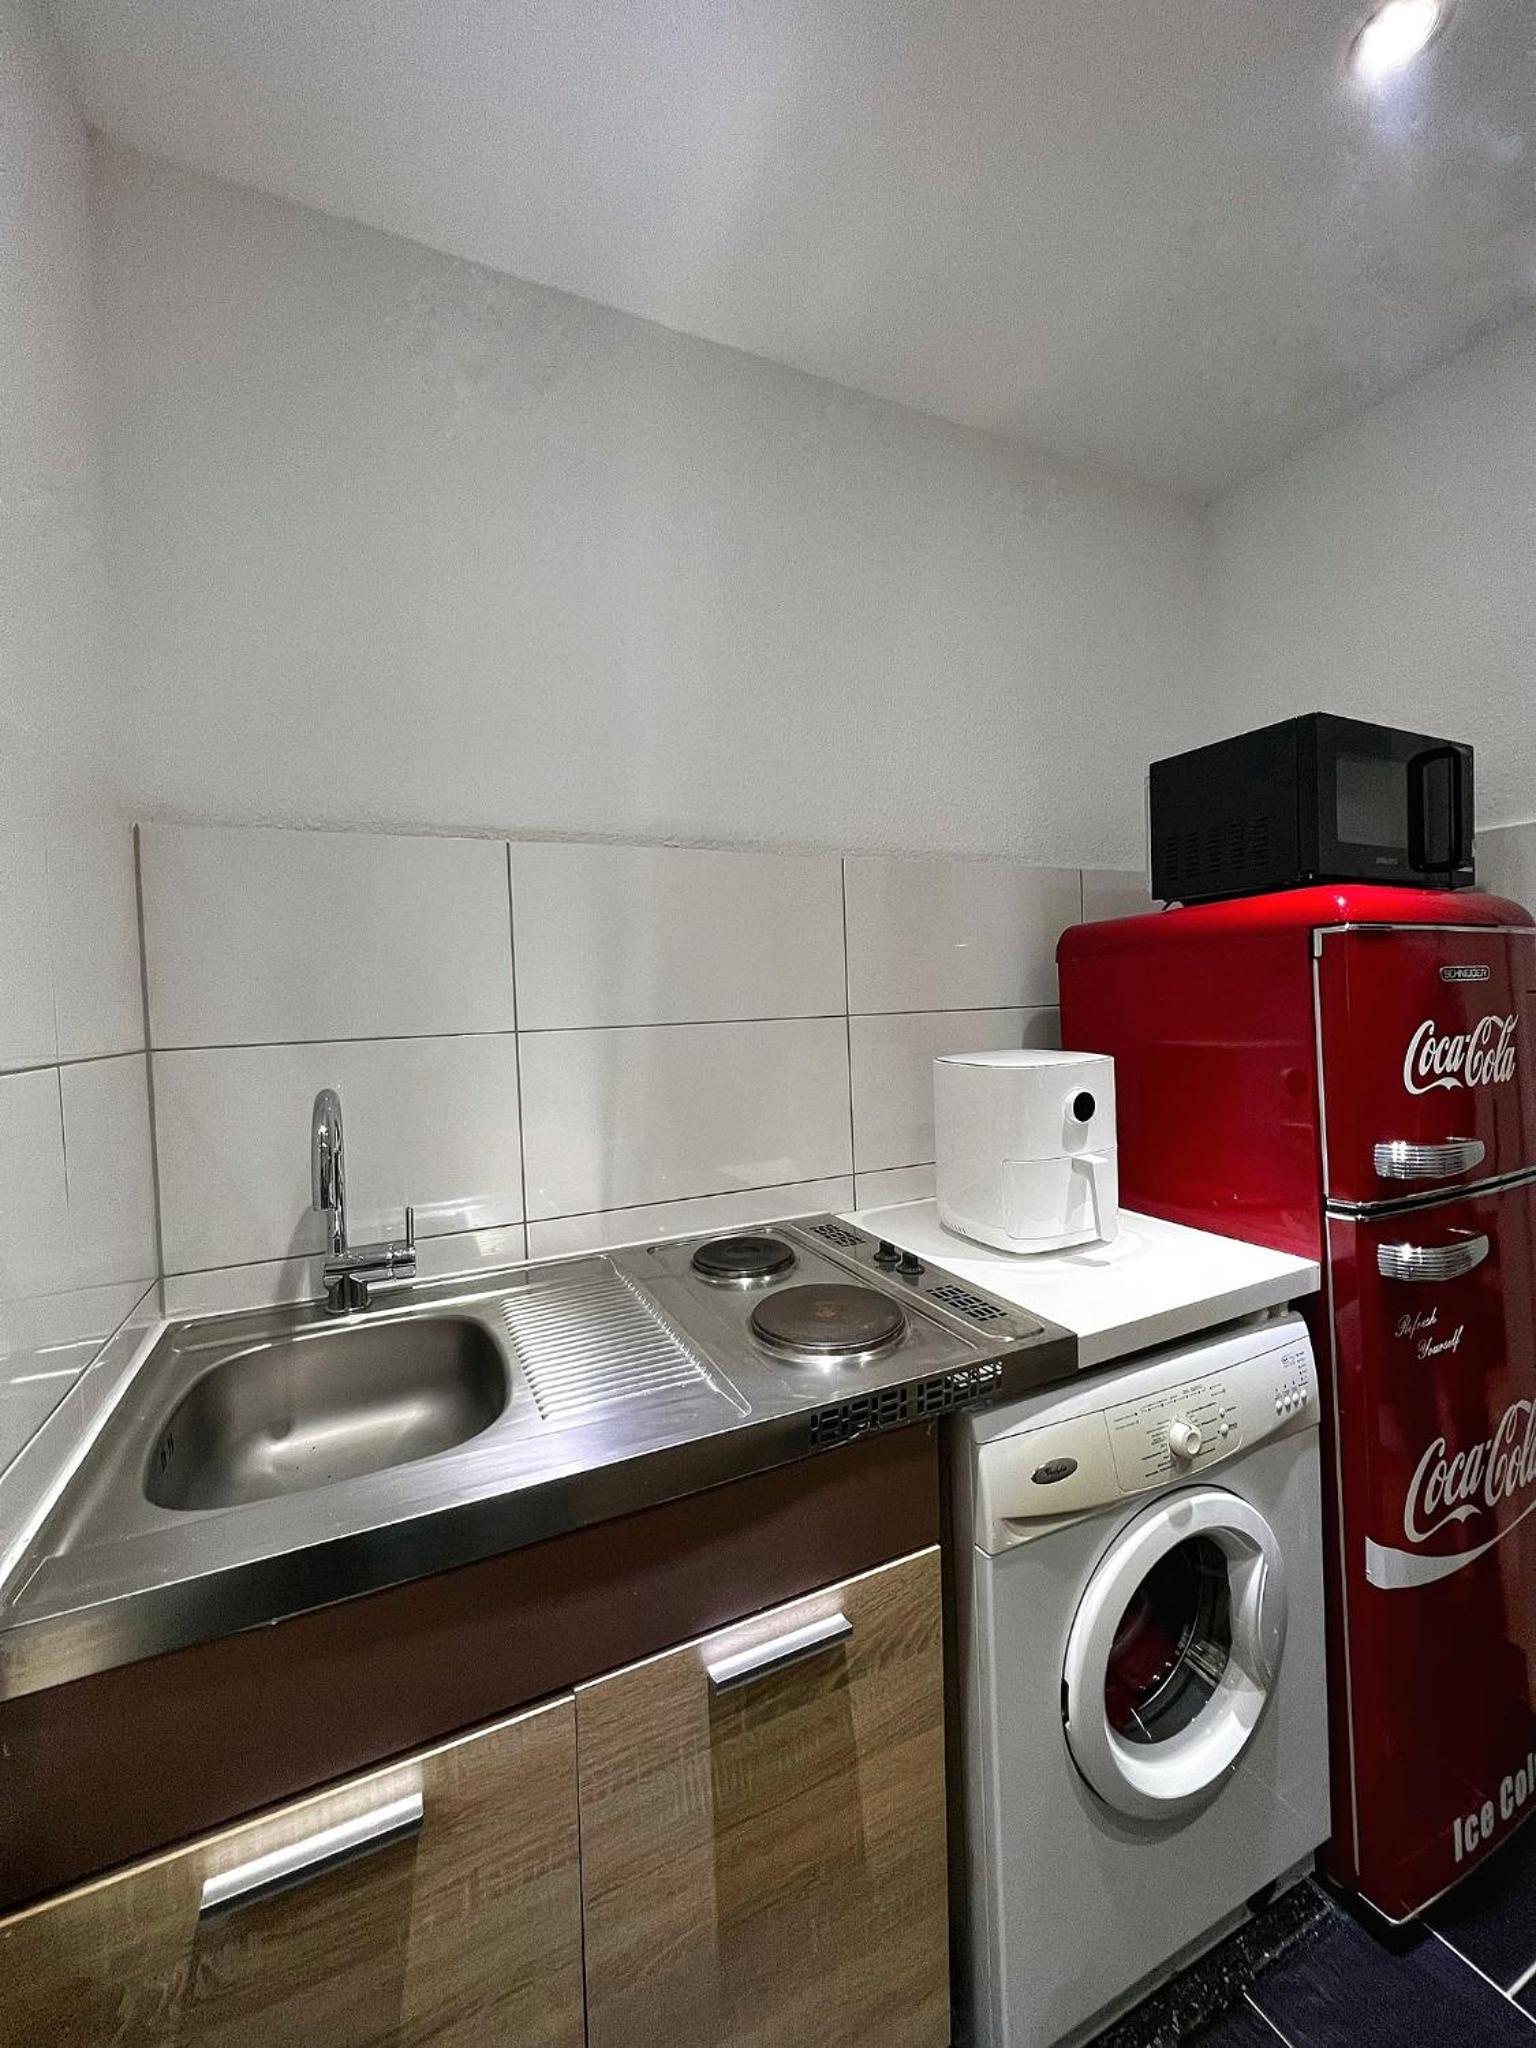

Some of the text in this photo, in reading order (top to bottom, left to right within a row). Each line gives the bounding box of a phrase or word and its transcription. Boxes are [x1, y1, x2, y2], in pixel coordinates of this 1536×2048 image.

[1443, 968, 1488, 979] SCHNEIDER
[1403, 1014, 1519, 1095] Coca-Cola
[1453, 1752, 1536, 1864] Ice Col
